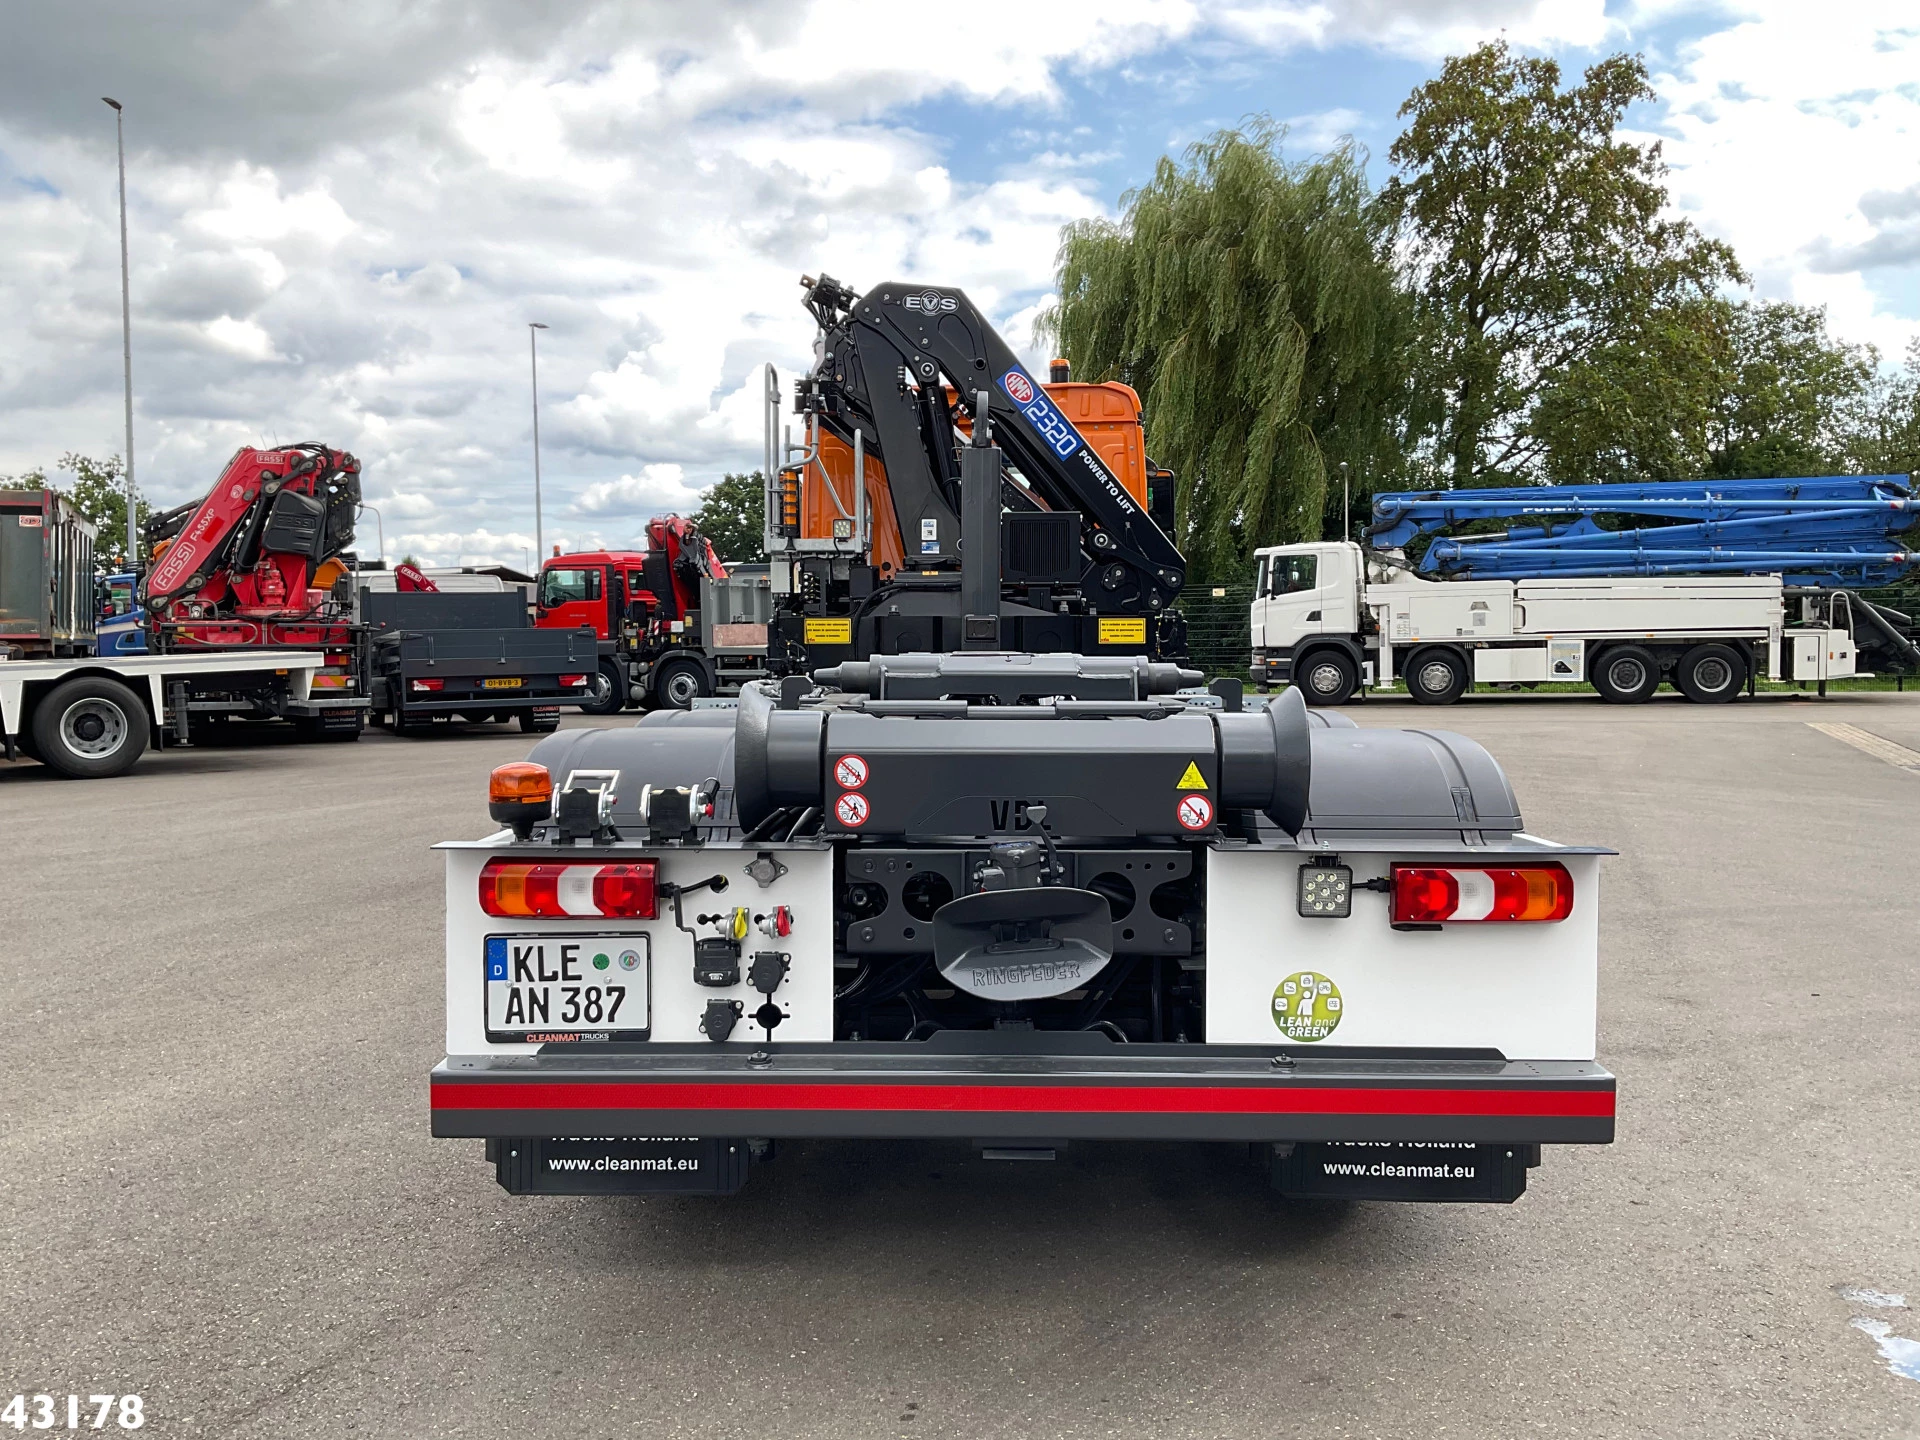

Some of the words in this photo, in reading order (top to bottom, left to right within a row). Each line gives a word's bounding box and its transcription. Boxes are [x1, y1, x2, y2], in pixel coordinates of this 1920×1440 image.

[1006, 374, 1032, 400] HMF
[1026, 400, 1077, 456] 2320
[259, 455, 284, 464] FASSI
[1078, 449, 1108, 484] POWER
[1105, 481, 1119, 496] TO
[1116, 492, 1136, 515] LIFT
[157, 545, 193, 587] FASSI
[493, 964, 503, 976] D
[513, 944, 582, 982] KLE
[972, 960, 1081, 986] RINGFEDER
[505, 986, 549, 1024] AN
[561, 986, 626, 1024] 387
[1280, 1016, 1312, 1027] LEAN
[1314, 1016, 1336, 1027] and
[1287, 1026, 1329, 1037] GREEN
[526, 1033, 581, 1043] CLEANMAT
[581, 1032, 610, 1040] TRUCKS
[548, 1155, 699, 1171] www.cleanmat.eu
[1323, 1161, 1475, 1178] www.cleanmat.eu
